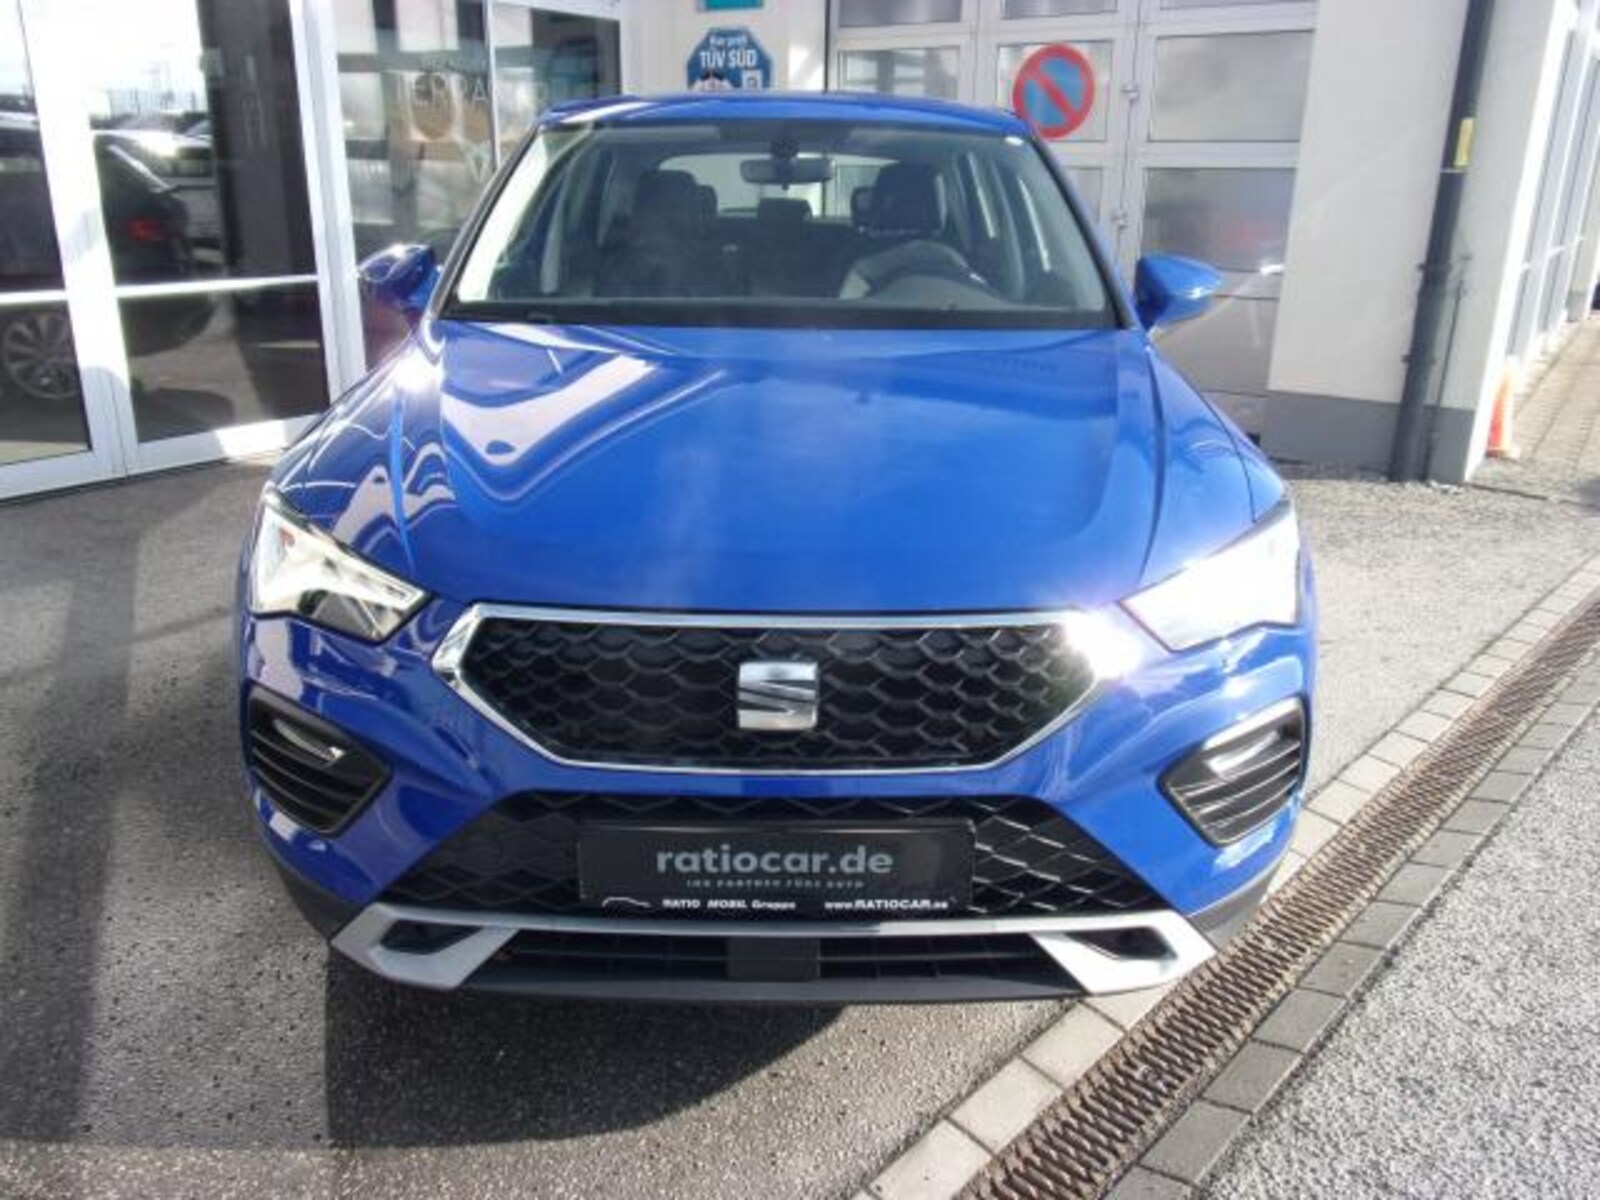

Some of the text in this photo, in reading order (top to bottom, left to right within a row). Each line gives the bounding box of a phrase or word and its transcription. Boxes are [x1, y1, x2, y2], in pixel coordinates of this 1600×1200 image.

[700, 46, 757, 69] TÜV SÜD
[656, 844, 893, 874] ratiocar.de
[662, 899, 796, 911] RATIO MOBIL Gruppe
